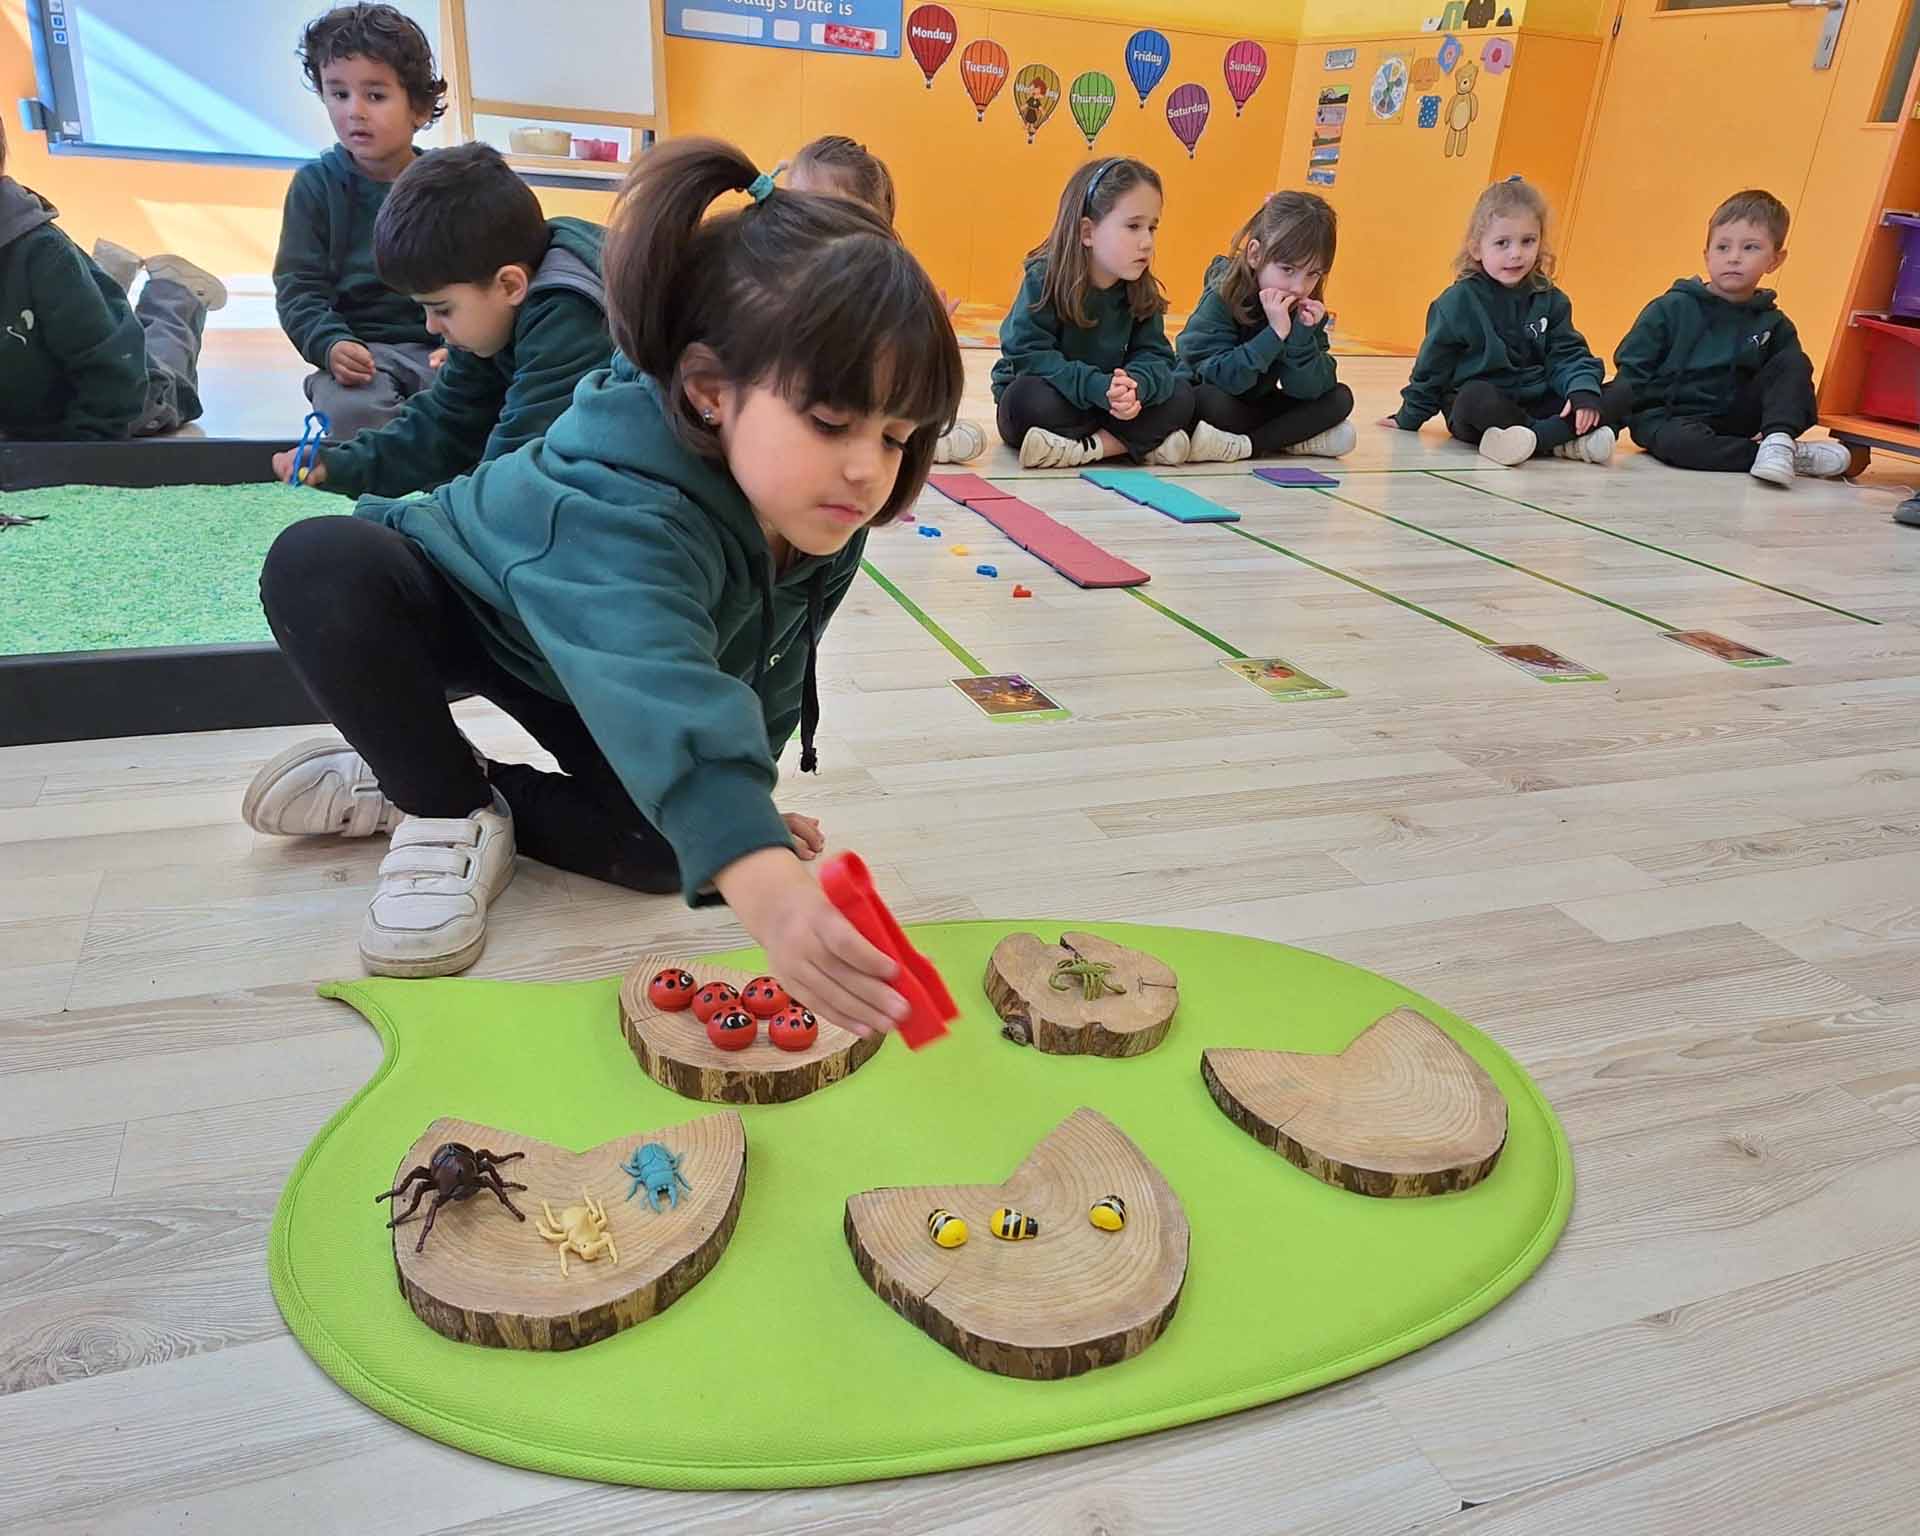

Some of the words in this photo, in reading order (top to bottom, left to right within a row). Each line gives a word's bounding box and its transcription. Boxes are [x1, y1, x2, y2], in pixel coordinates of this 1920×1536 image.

[794, 0, 833, 15] Date
[839, 0, 853, 16] is
[911, 26, 952, 44] Monday
[1133, 51, 1163, 66] Friday
[964, 60, 1005, 77] Tuesday
[1229, 60, 1262, 76] Sunday
[1071, 93, 1114, 106] Thursday
[1167, 102, 1209, 119] Saturday
